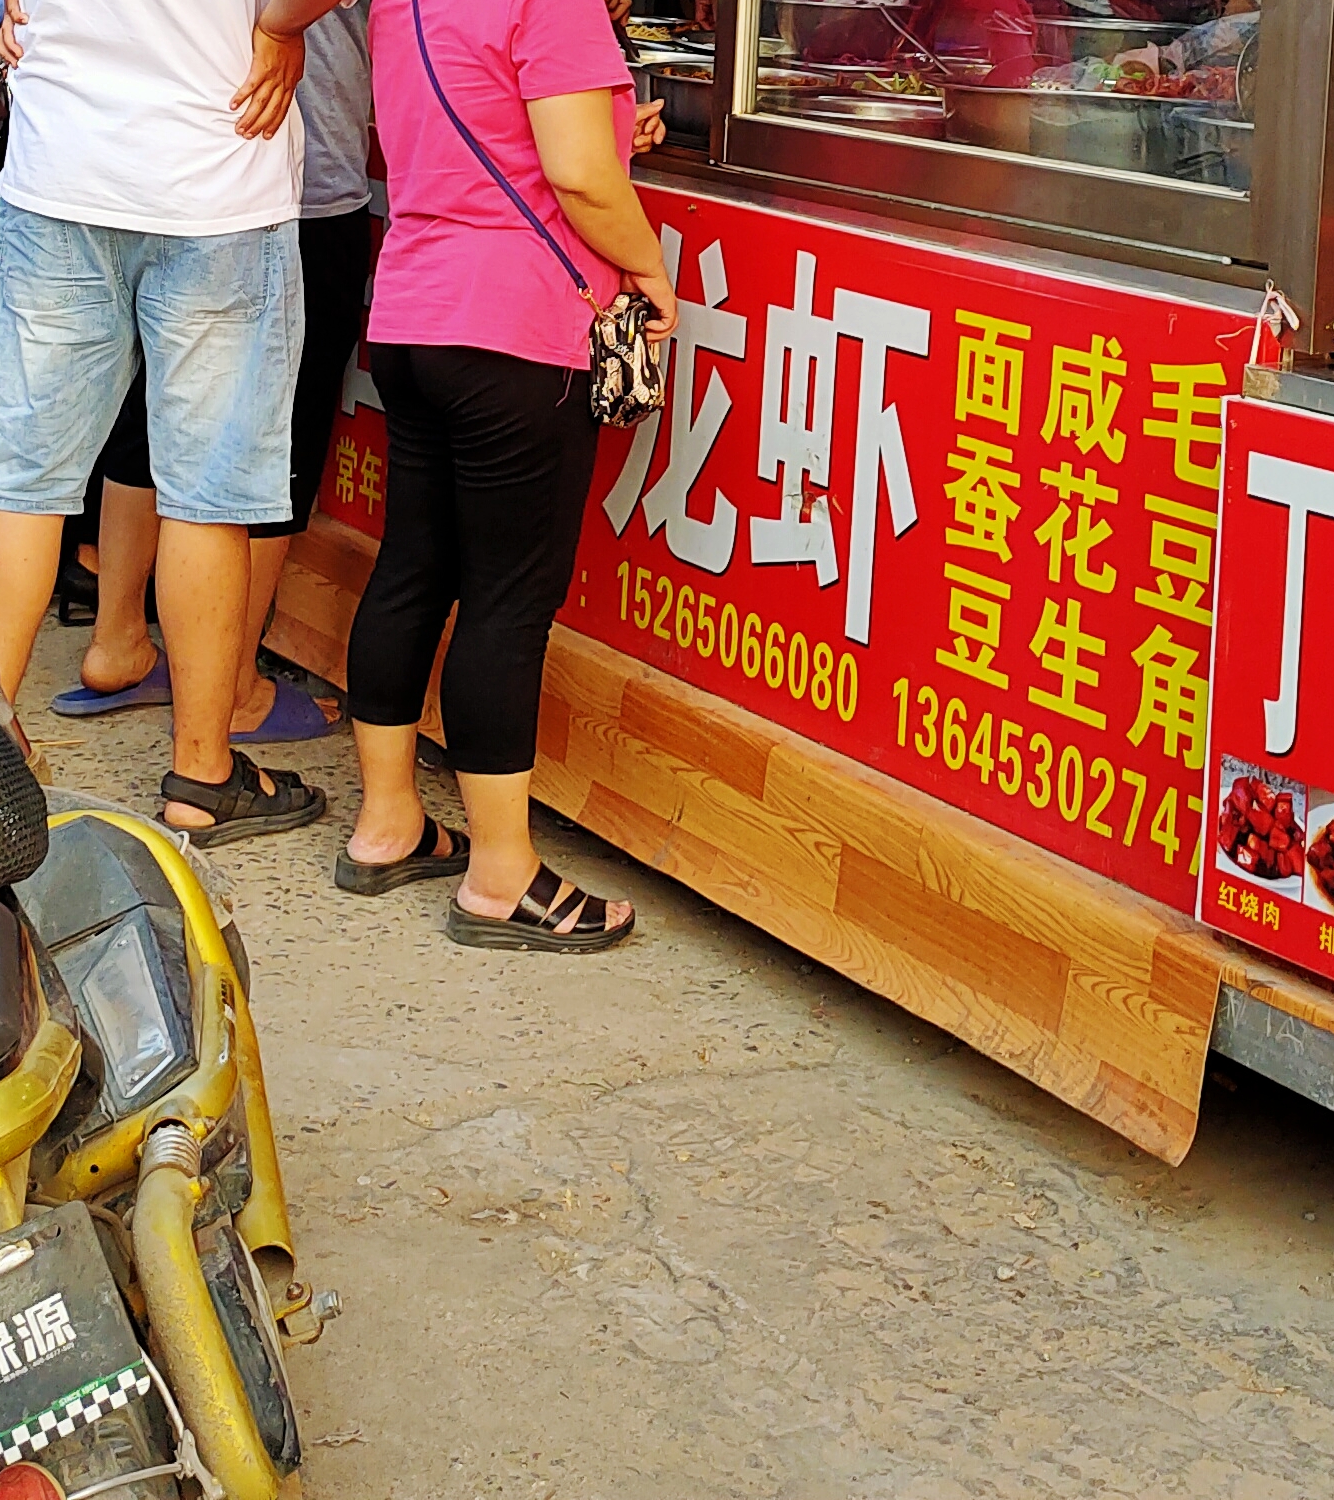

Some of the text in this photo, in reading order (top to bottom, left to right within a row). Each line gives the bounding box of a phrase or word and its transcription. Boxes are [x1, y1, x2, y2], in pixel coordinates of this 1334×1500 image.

[616, 561, 859, 724] 15265066080
[936, 308, 1053, 691] 面蚕豆
[1026, 334, 1130, 730] 咸花生
[1125, 360, 1227, 771] 毛豆角
[1217, 881, 1282, 933] 红烧肉
